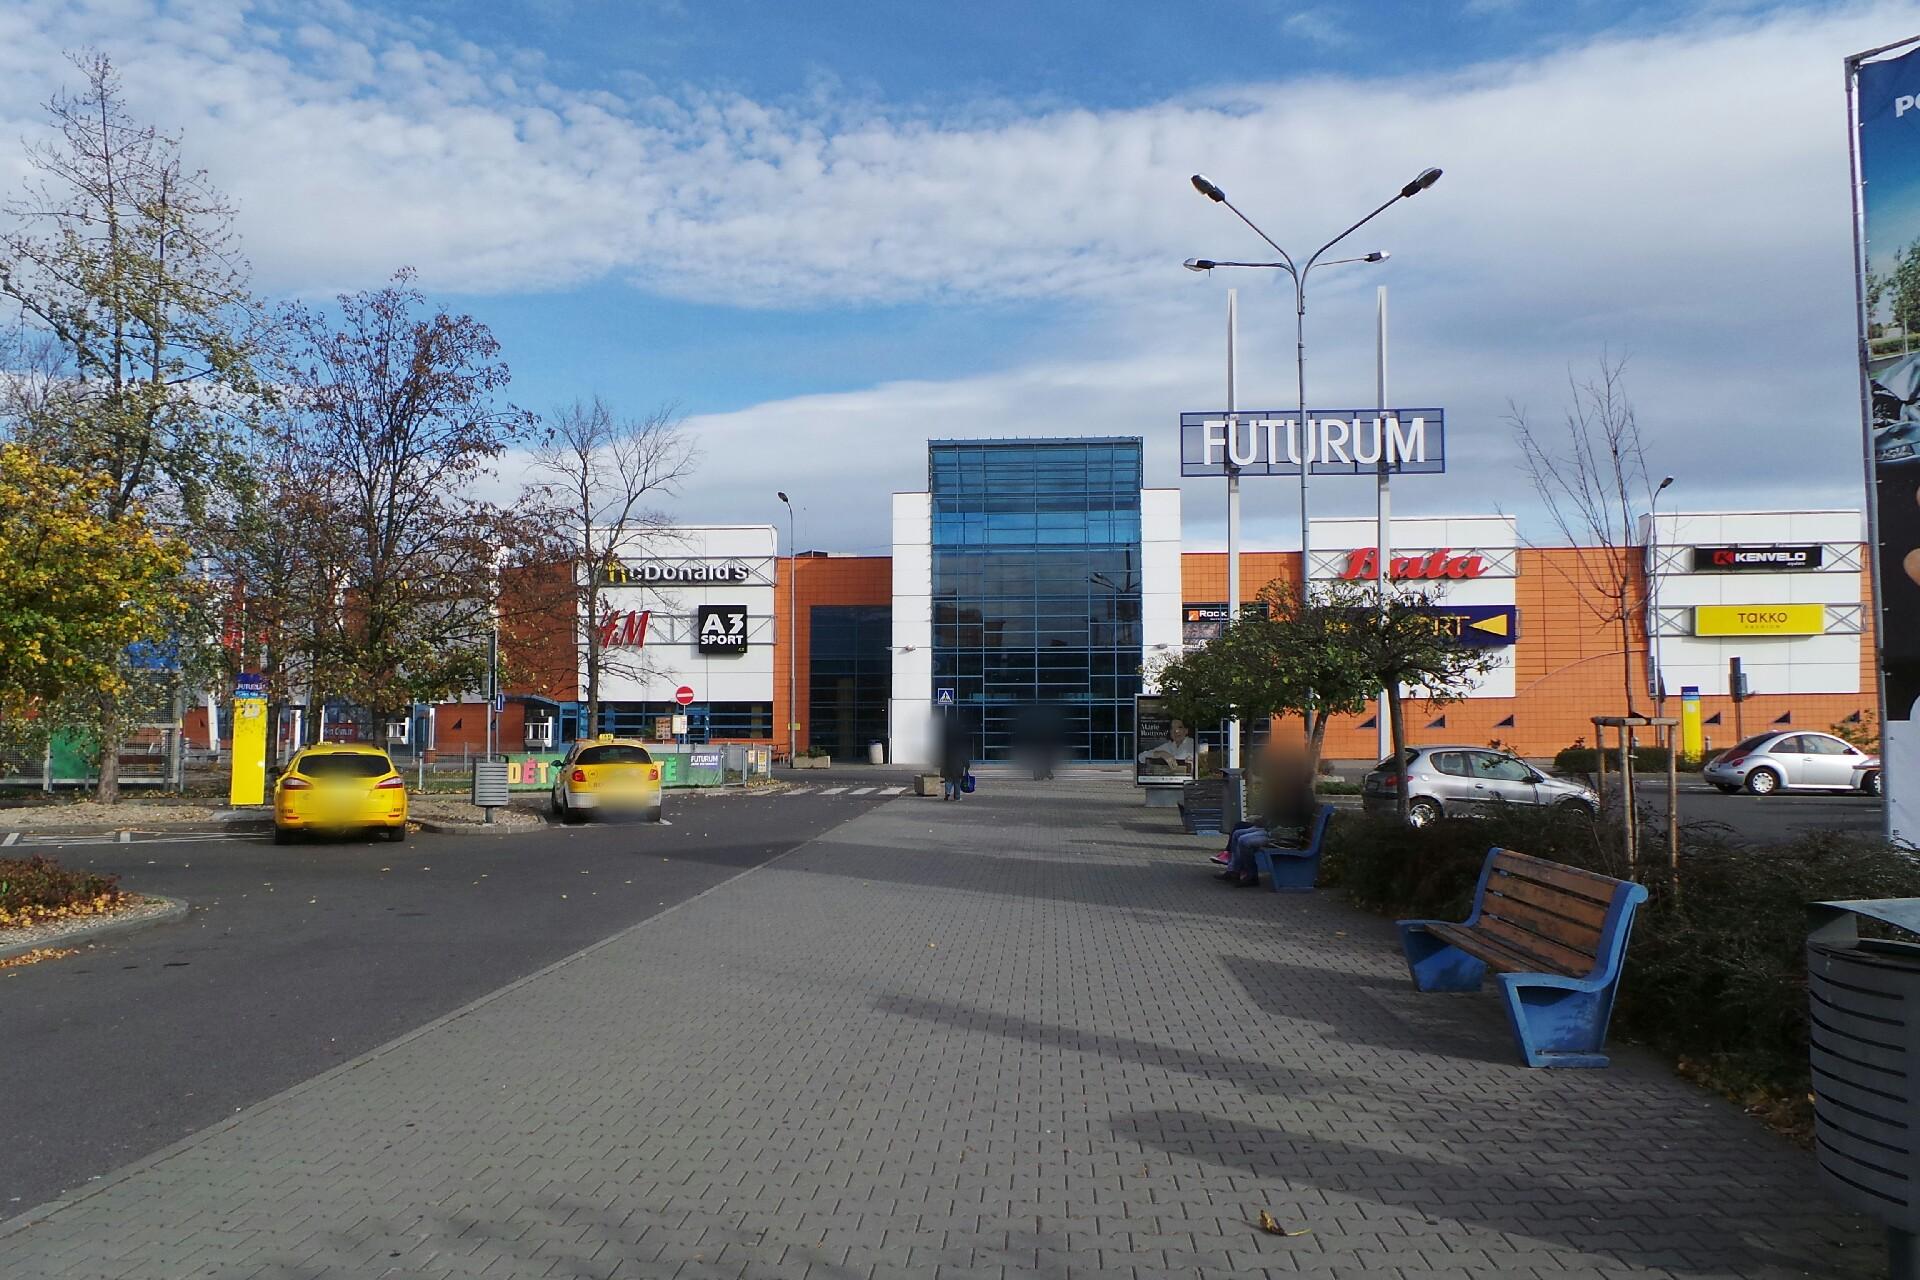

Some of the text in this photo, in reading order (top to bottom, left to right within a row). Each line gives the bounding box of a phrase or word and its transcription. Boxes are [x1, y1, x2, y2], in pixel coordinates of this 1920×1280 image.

[1203, 417, 1425, 466] FUTURUM
[1735, 552, 1806, 562] KENVELO
[700, 634, 744, 645] SPORT
[690, 755, 719, 763] FUTURUM
